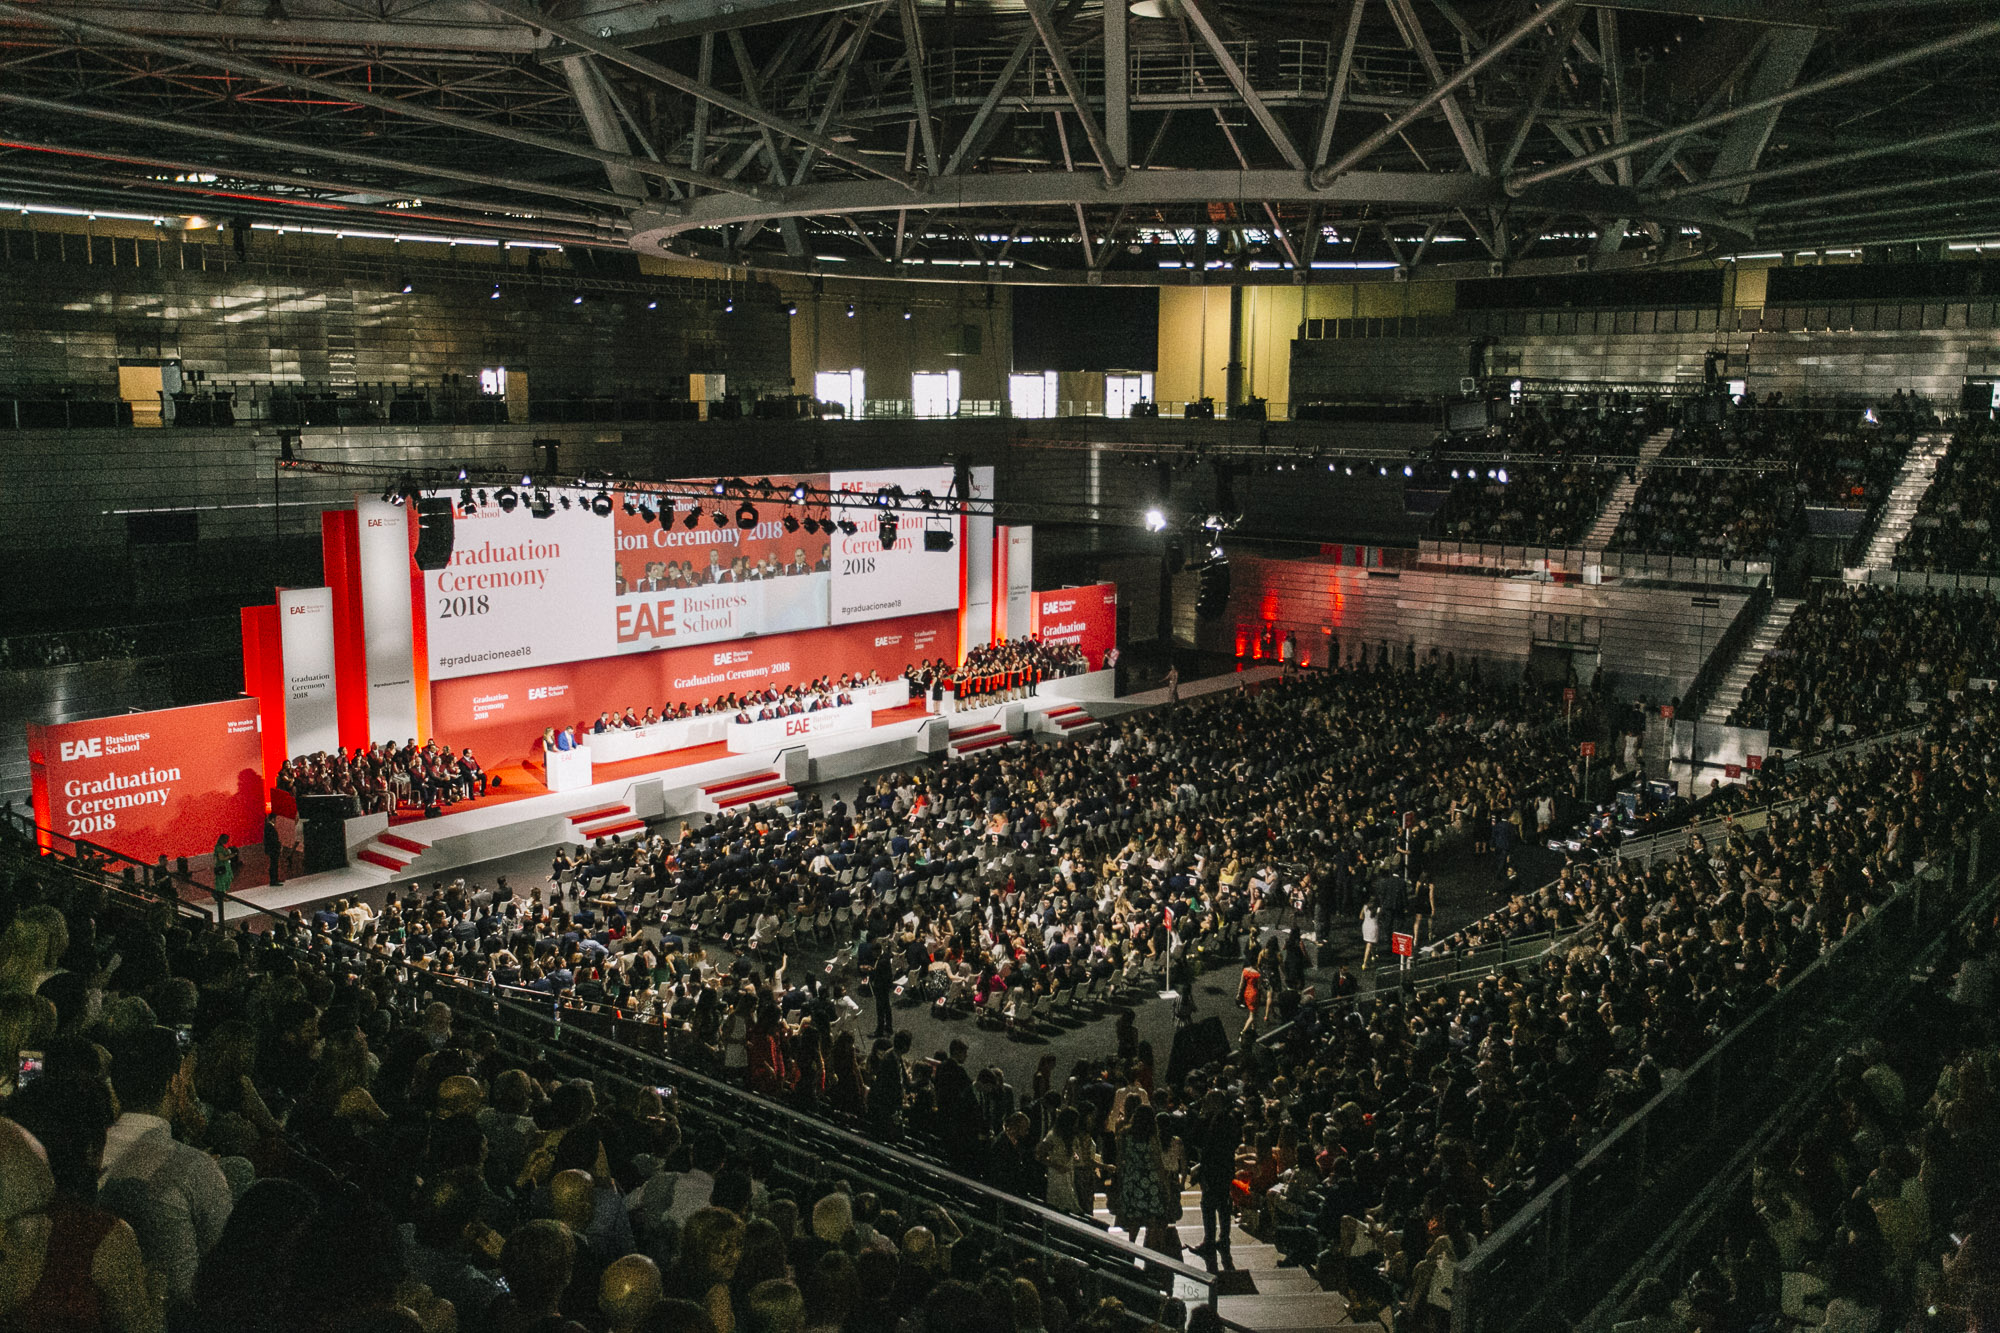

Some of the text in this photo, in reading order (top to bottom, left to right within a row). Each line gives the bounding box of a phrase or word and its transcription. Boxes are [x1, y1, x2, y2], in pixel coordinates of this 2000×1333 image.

[368, 519, 382, 527] EAE
[653, 527, 741, 548] Ceremony
[747, 521, 783, 541] 2018
[452, 539, 561, 566] raduation
[843, 557, 875, 575] 2018
[438, 568, 550, 593] Ceremony
[290, 606, 305, 614] EAE
[439, 594, 490, 619] 2018
[683, 593, 747, 613] Business
[842, 600, 901, 614] #graduacioneae18
[1043, 601, 1058, 615] EAE
[616, 600, 676, 643] EAE
[683, 611, 733, 634] School
[1043, 621, 1086, 636] Graduation
[875, 636, 888, 647] EAE
[439, 646, 532, 668] #graduacioneae18
[713, 652, 732, 666] EAE
[291, 673, 330, 683] Graduation
[674, 662, 790, 688] Graduation Ceremony 2018
[292, 682, 326, 692] Ceremony
[528, 687, 547, 700] EAE
[293, 691, 308, 700] 2018
[473, 693, 508, 704] Graduation
[473, 702, 505, 712] Ceremony
[786, 718, 810, 736] EAE
[105, 731, 150, 746] Business
[61, 737, 103, 762] EAE
[105, 740, 140, 755] School
[64, 766, 181, 798] Graduation
[66, 787, 171, 817] Ceremony
[68, 813, 117, 837] 2018
[1183, 1284, 1199, 1298] 105
